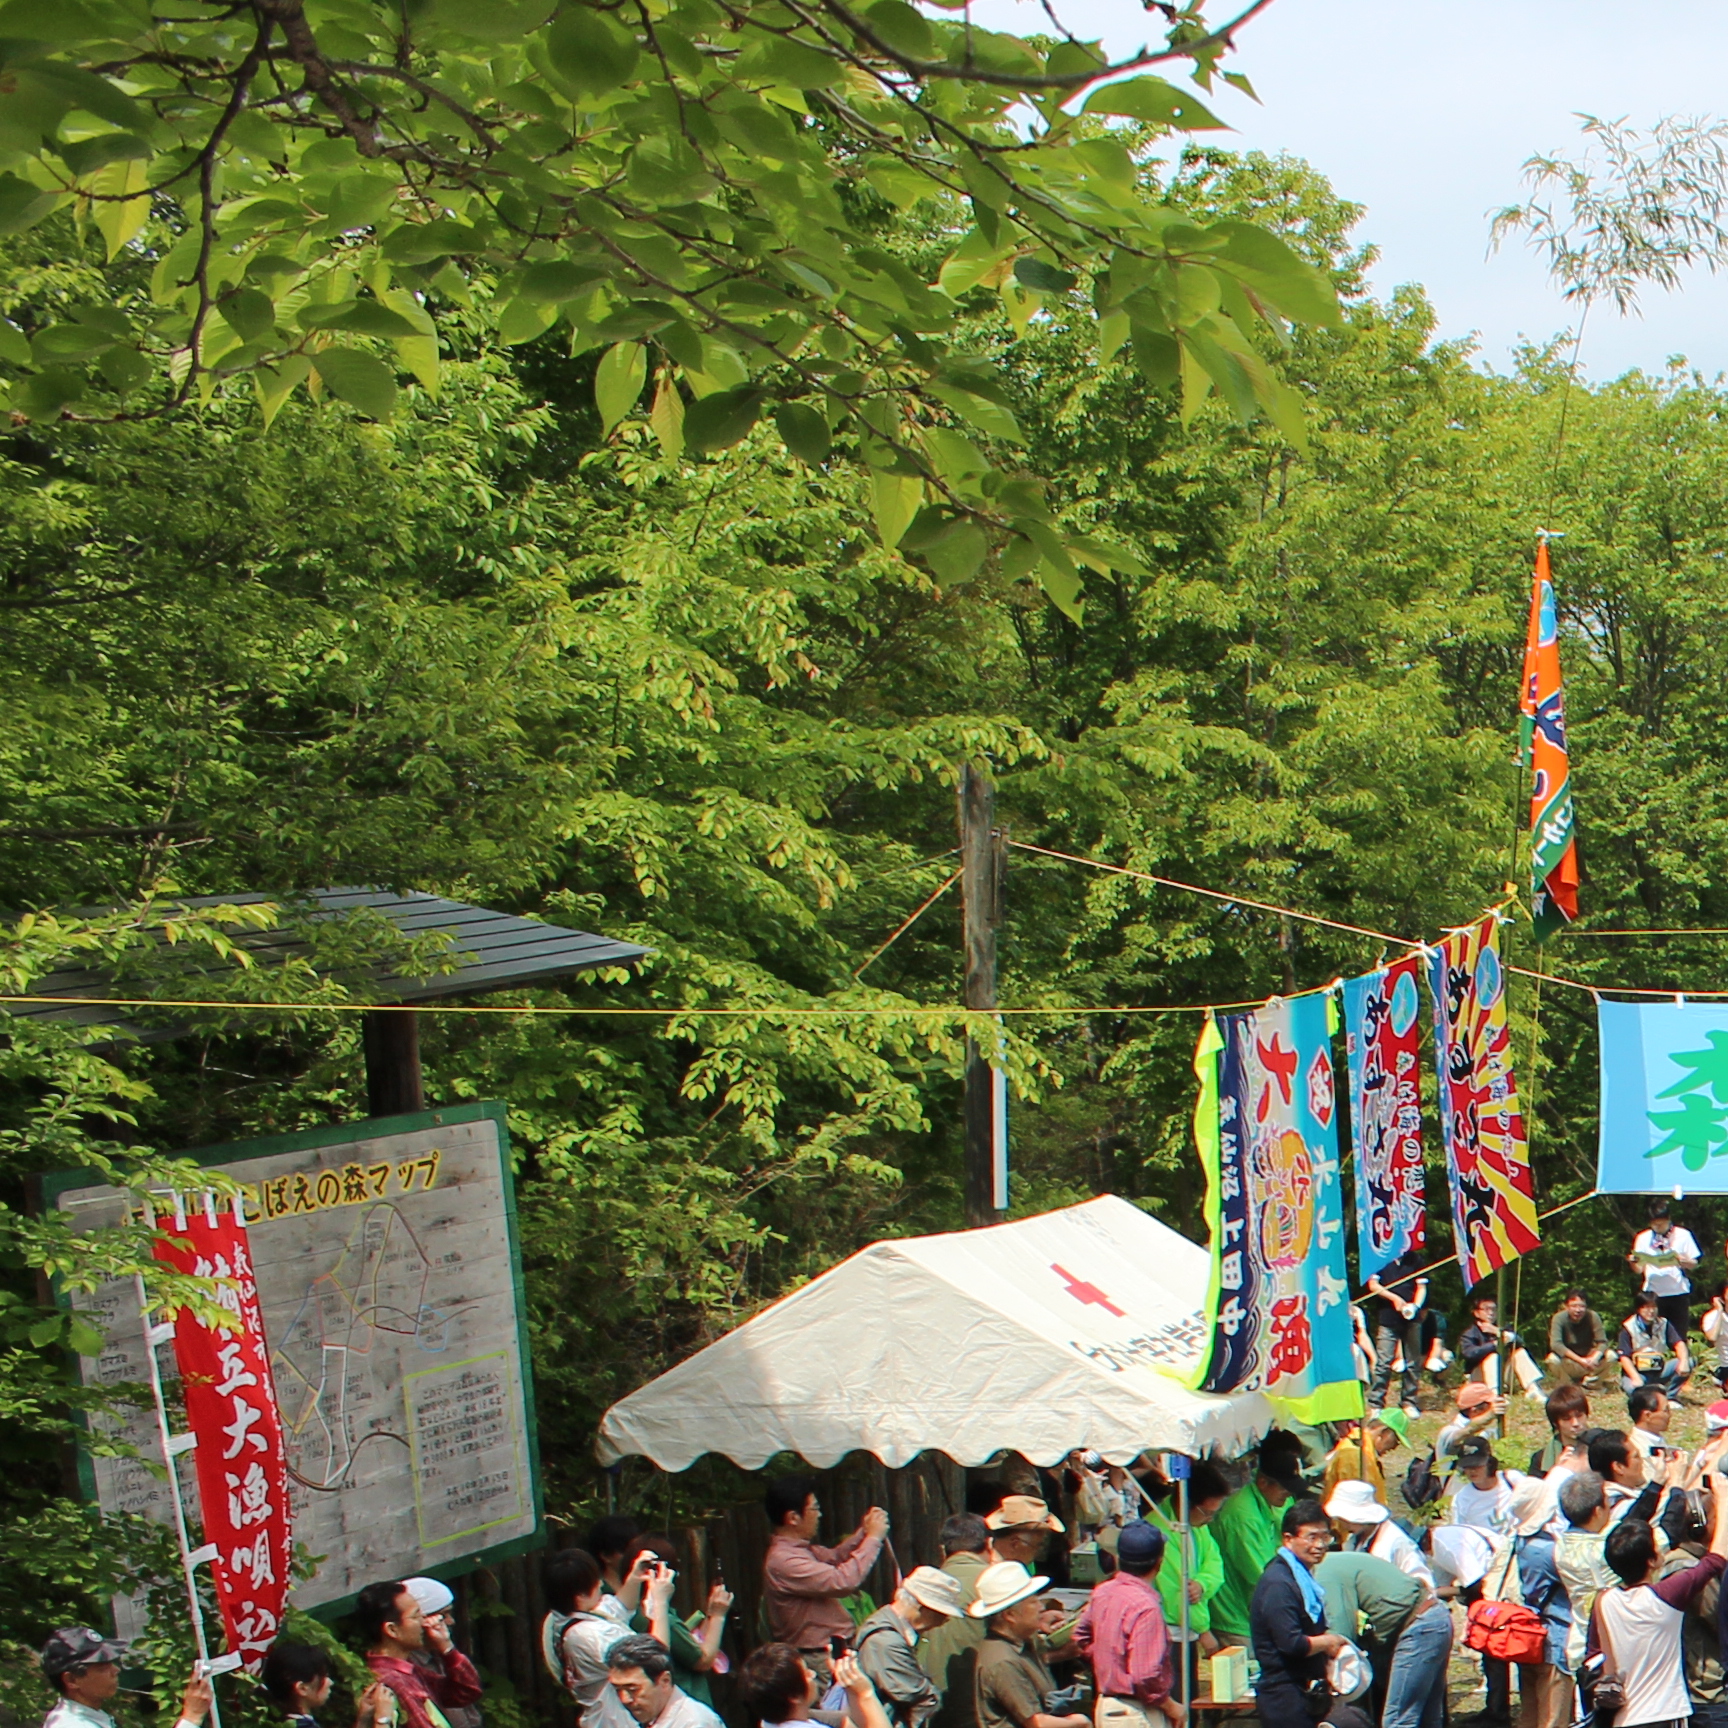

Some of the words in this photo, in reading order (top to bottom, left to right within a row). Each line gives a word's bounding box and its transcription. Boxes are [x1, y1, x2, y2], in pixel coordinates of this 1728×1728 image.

[1217, 1212, 1248, 1336] 上田中
[1313, 1146, 1348, 1318] 水山丸
